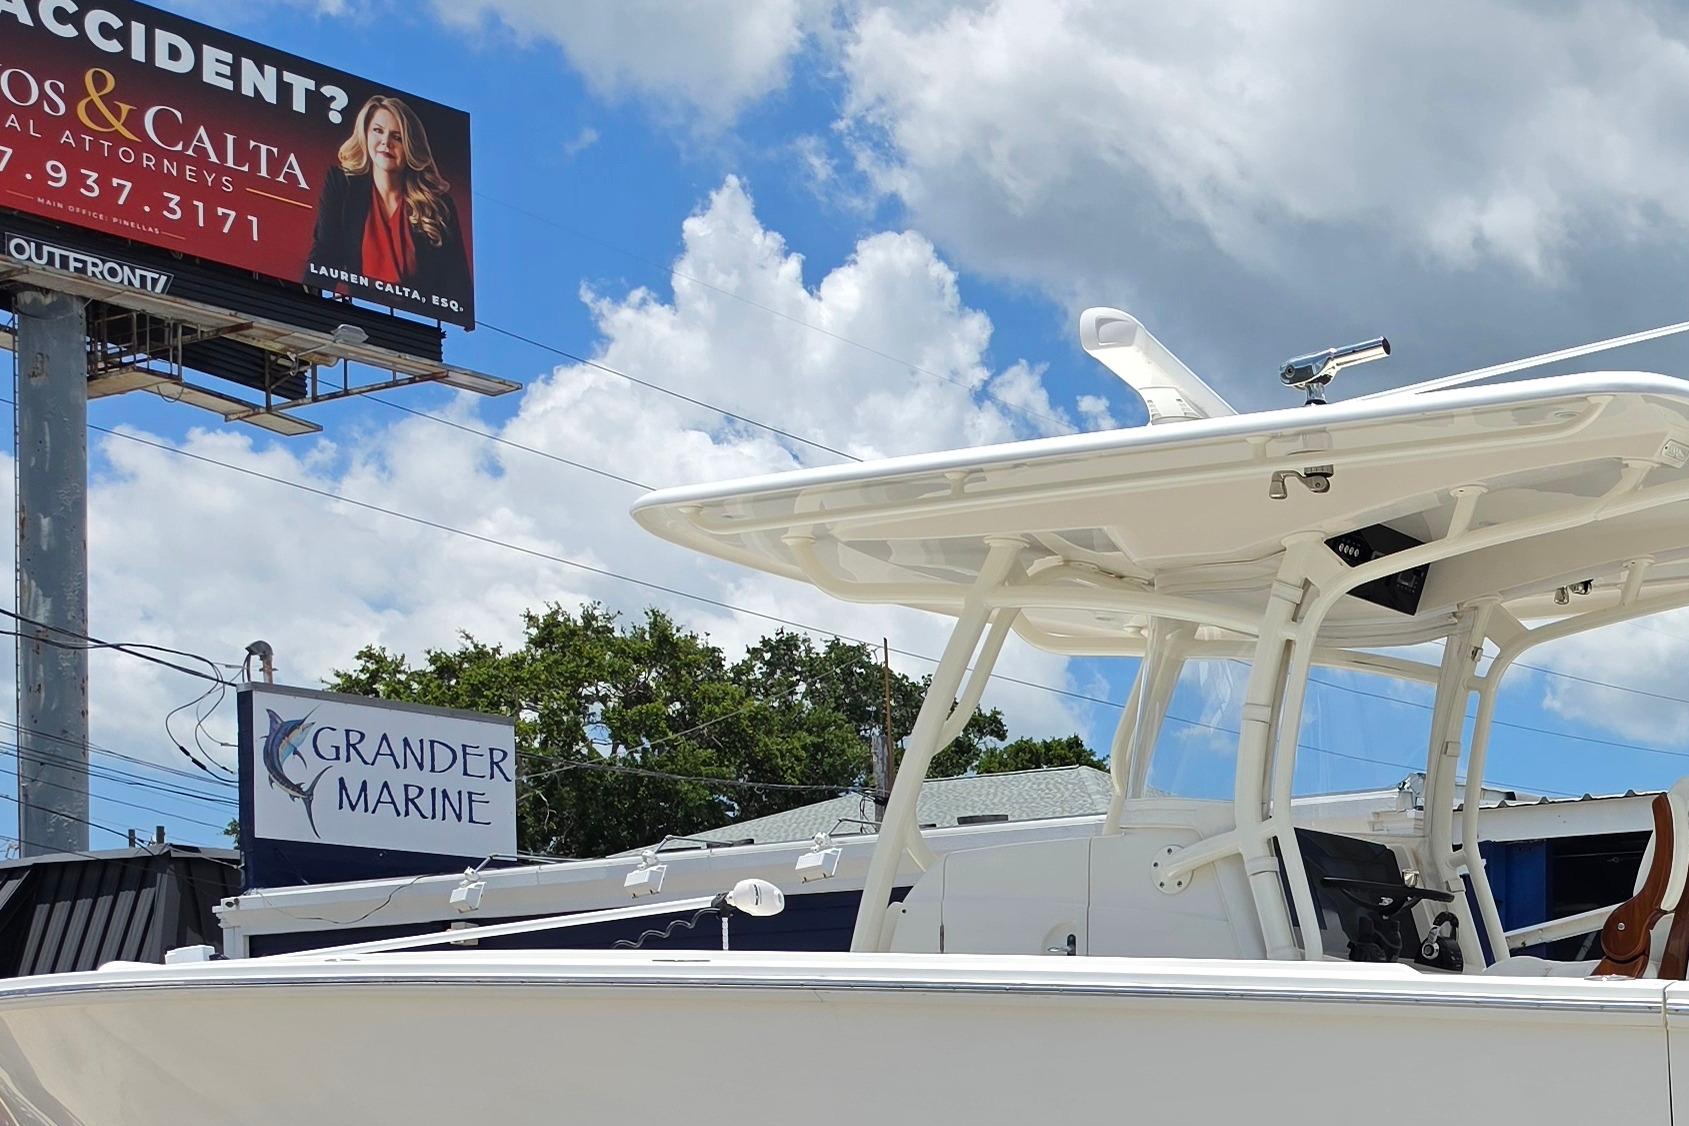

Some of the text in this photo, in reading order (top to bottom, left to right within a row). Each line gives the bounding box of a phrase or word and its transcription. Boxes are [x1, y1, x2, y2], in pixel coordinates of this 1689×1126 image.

[0, 0, 350, 125] ACCIDENT?
[60, 129, 234, 193] ATTORNEYS
[37, 196, 64, 209] MAIN
[113, 217, 161, 235] PINELLAS
[310, 263, 465, 313] LAUREN CALTA, ESQ.
[312, 726, 513, 783] GRANDER
[338, 776, 491, 826] MARINE
